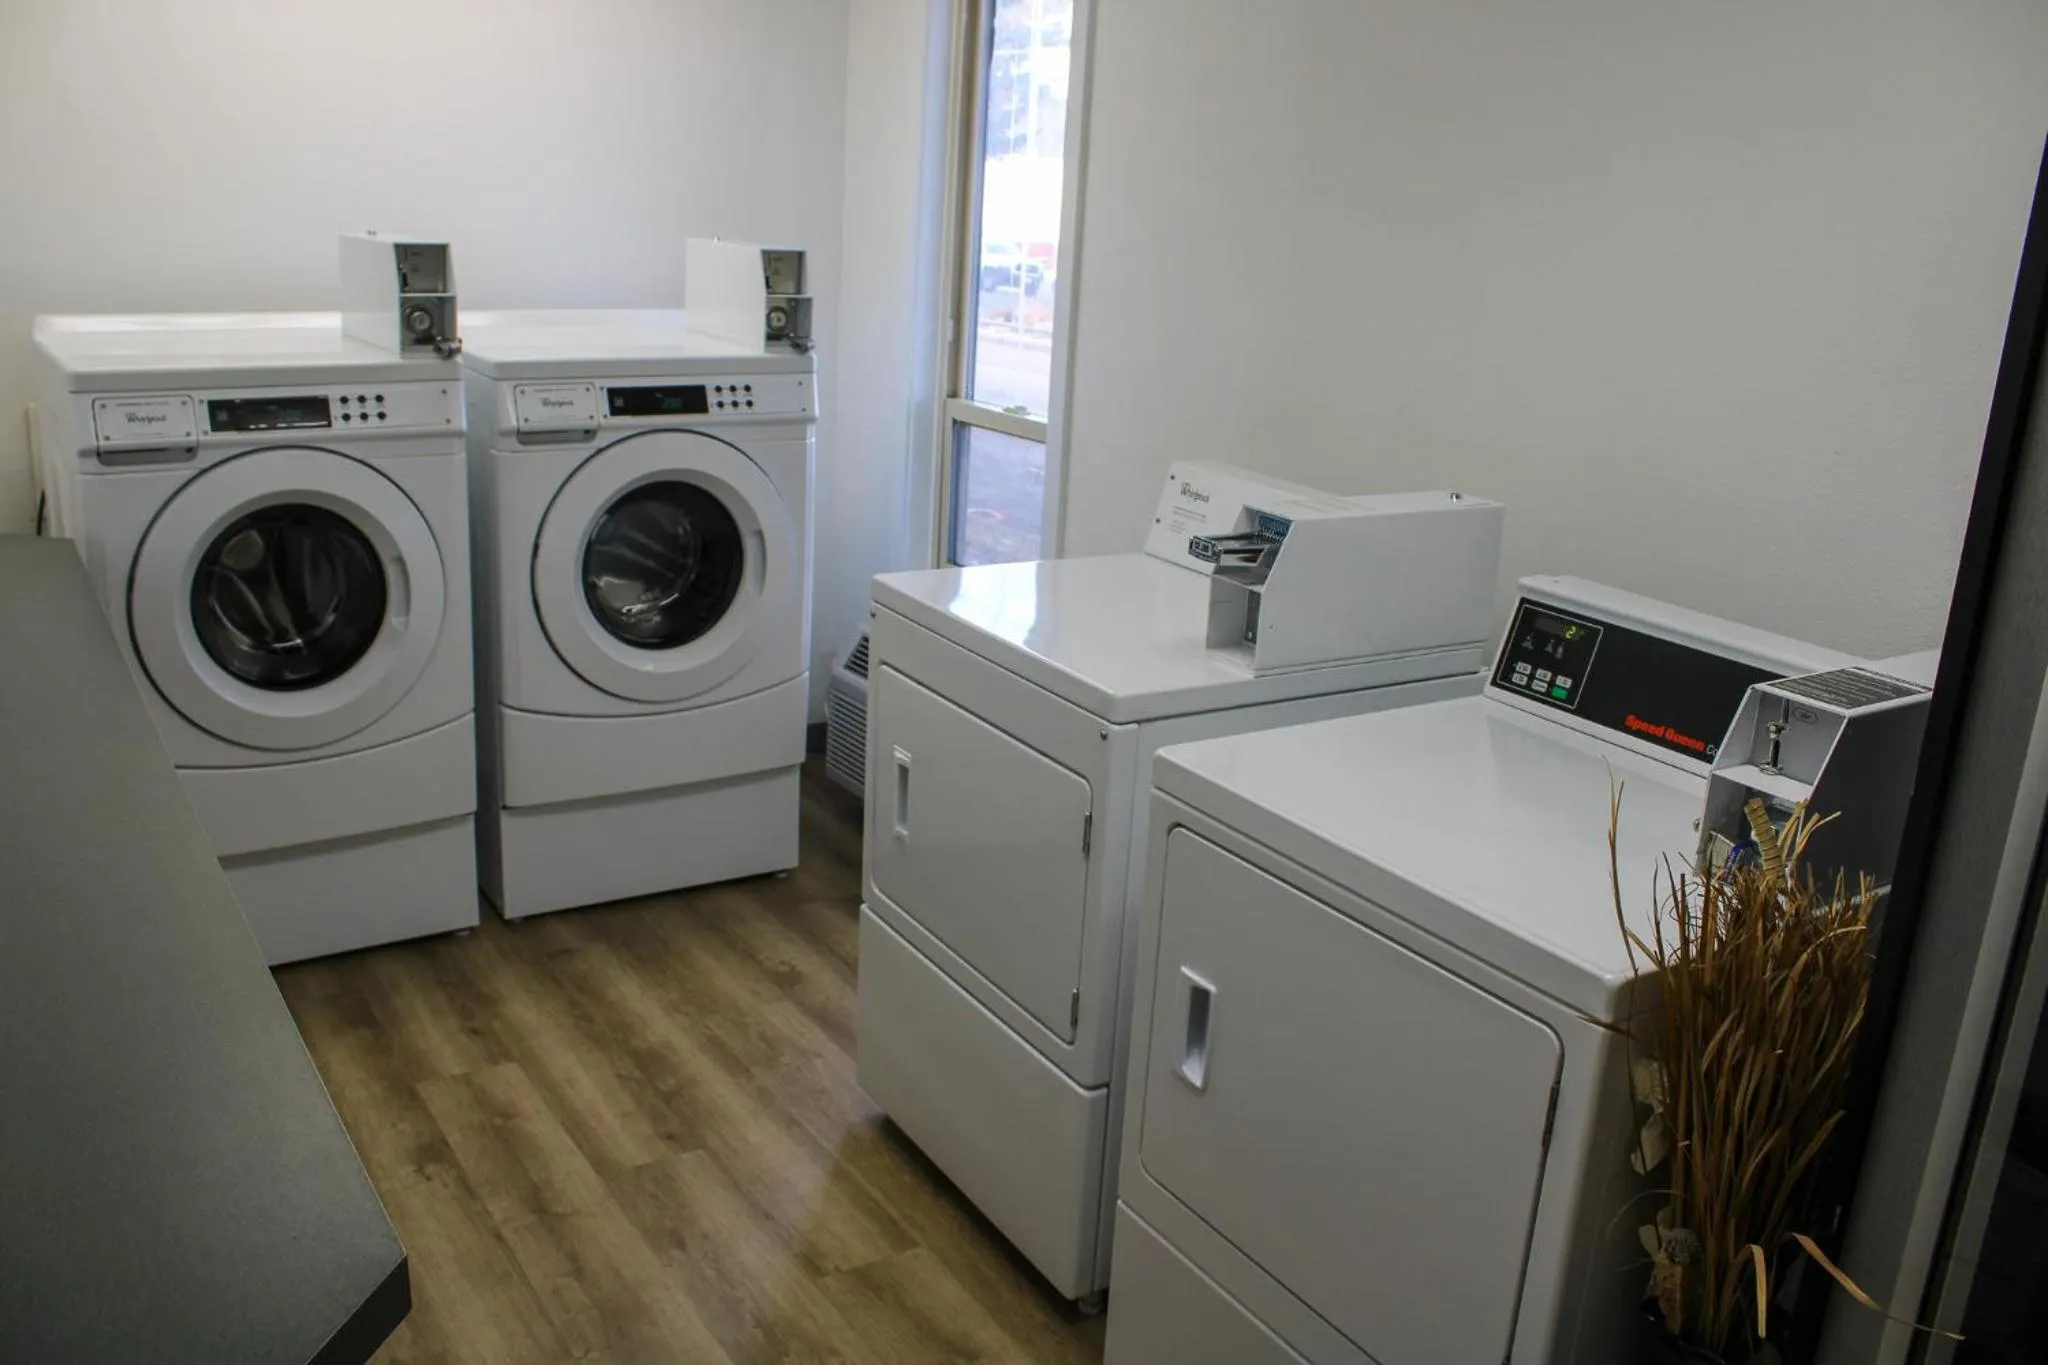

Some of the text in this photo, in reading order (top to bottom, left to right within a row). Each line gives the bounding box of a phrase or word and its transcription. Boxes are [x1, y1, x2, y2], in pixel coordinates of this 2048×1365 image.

[1566, 626, 1577, 639] 2
[1625, 715, 1665, 736] Speed
[1666, 728, 1705, 752] Queen
